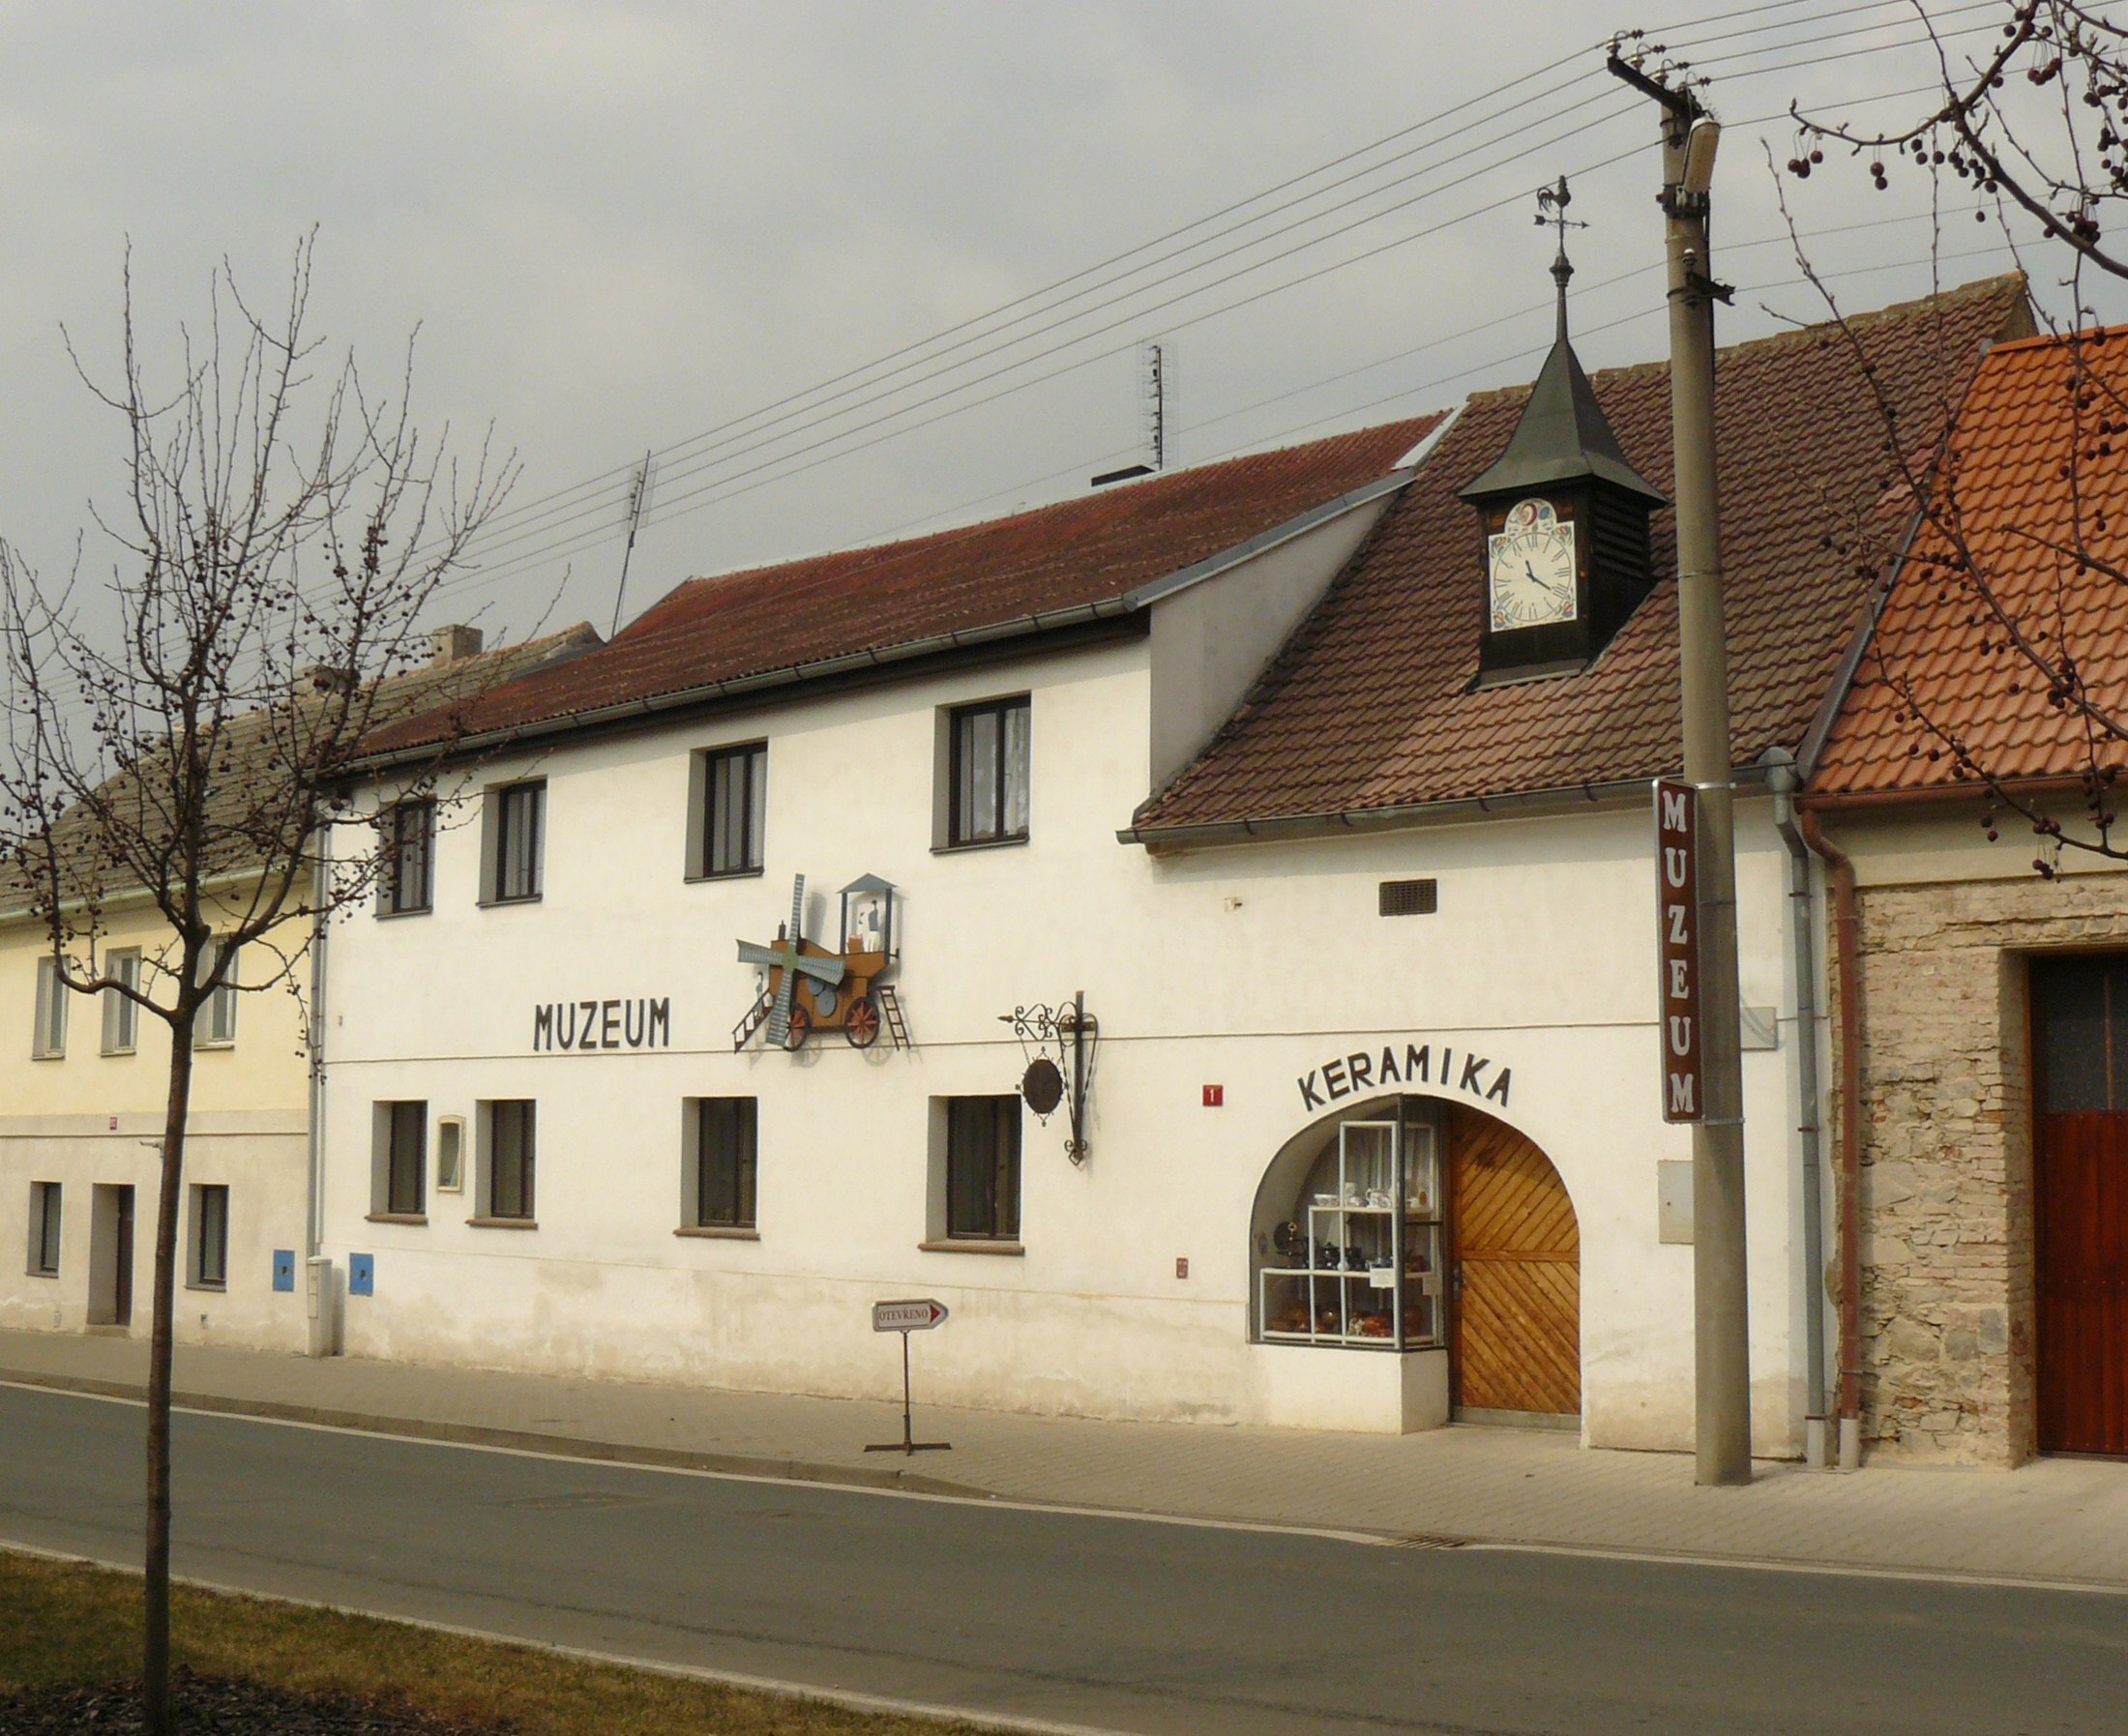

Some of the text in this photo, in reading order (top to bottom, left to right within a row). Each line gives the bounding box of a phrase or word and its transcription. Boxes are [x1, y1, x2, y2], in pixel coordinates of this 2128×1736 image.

[1663, 790, 1695, 1113] MUZEUM
[533, 997, 669, 1051] MUZEUM
[1209, 1088, 1214, 1103] 1
[1297, 1044, 1512, 1112] KERAMIKA
[878, 1308, 929, 1321] OTEVŘENO
